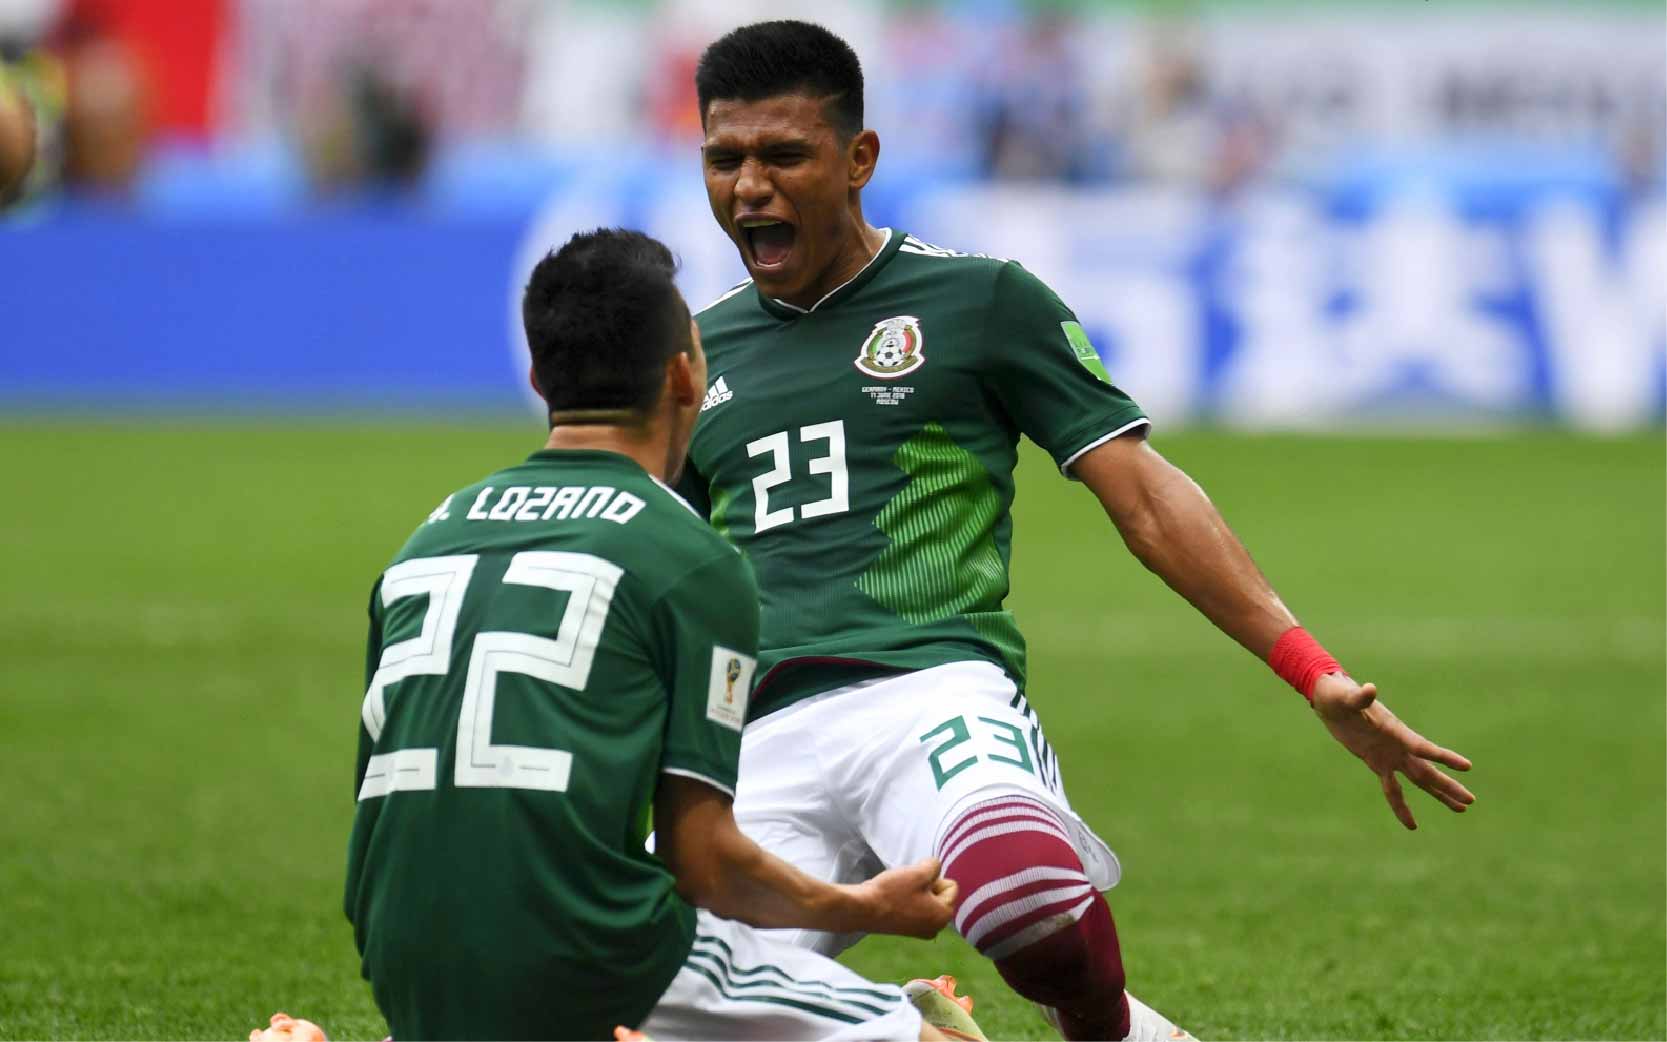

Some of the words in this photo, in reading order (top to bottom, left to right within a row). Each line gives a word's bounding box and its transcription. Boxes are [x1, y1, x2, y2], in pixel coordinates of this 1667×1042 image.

[466, 486, 646, 524] LOZANO
[746, 420, 849, 534] 23
[358, 551, 625, 801] 22
[920, 715, 1035, 792] 23
